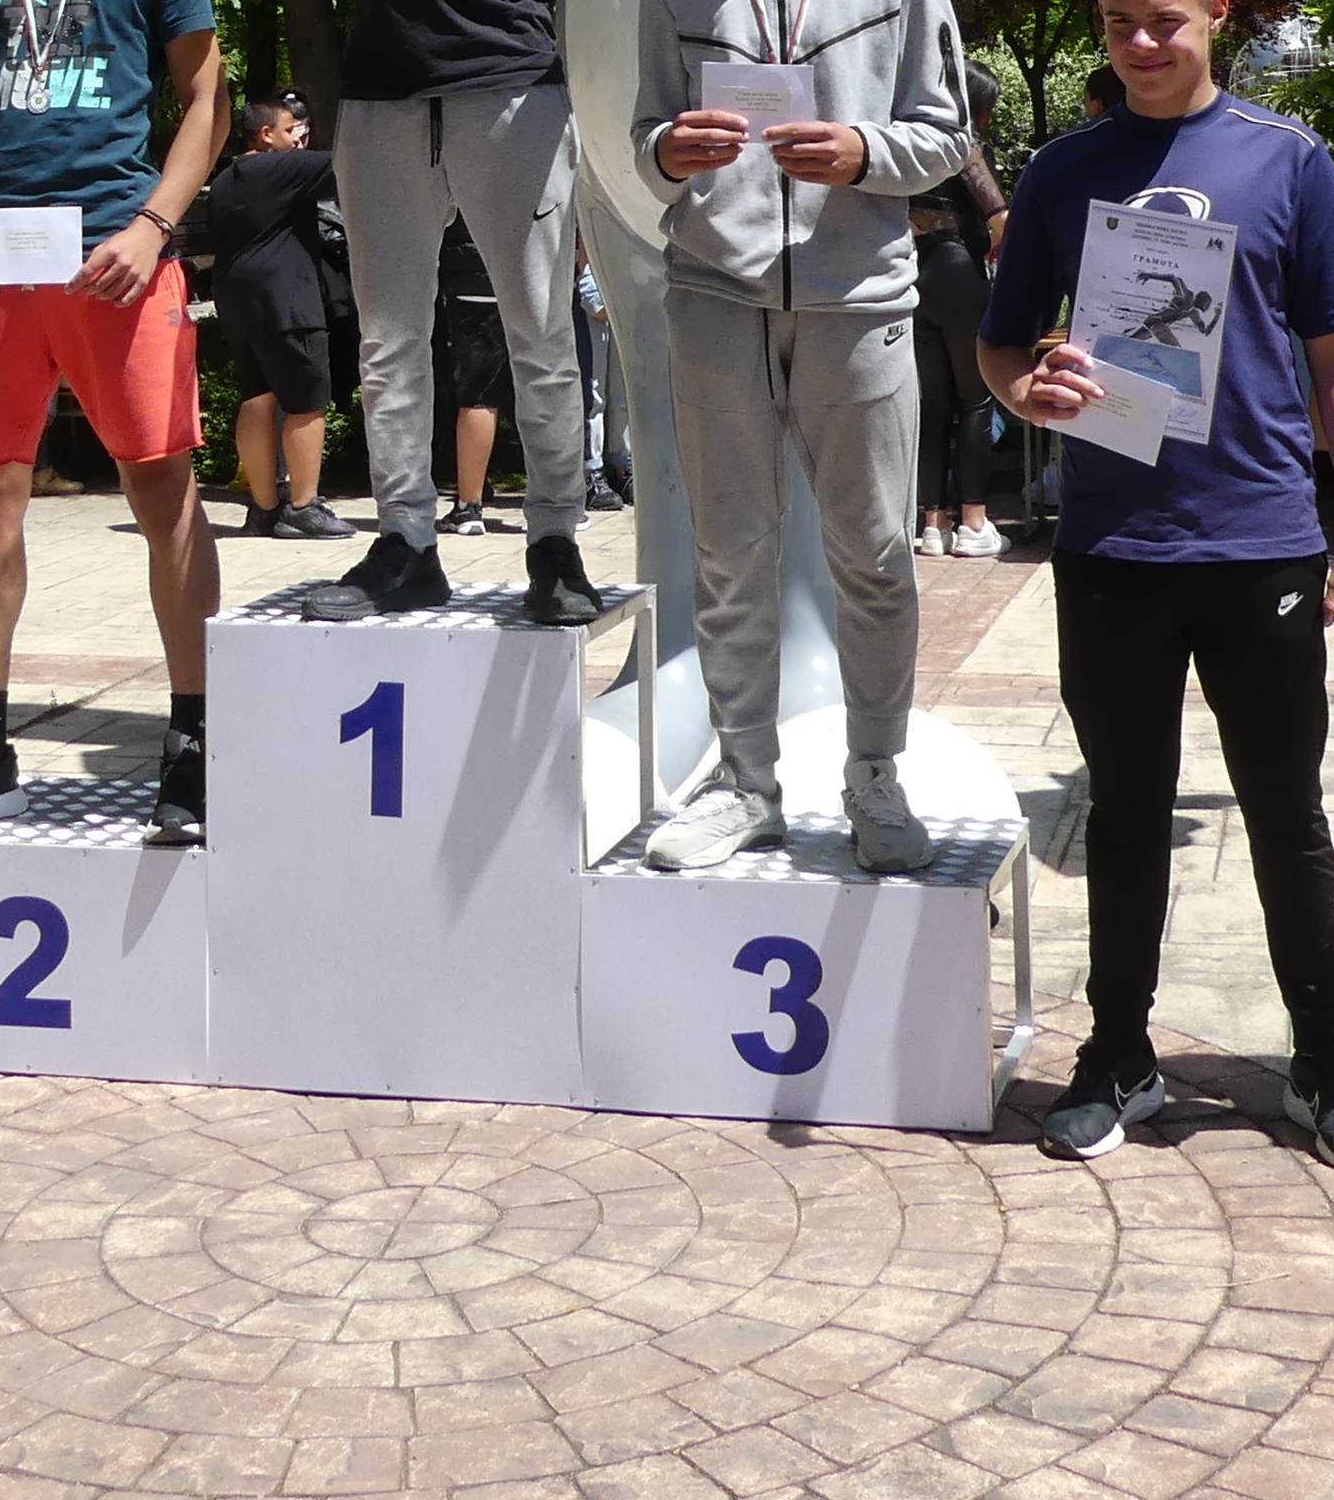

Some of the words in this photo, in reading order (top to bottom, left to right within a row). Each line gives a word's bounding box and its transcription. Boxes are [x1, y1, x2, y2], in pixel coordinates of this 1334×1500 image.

[1132, 254, 1180, 269] ГРАМОТА
[887, 323, 905, 337] NIKE
[339, 682, 404, 817] 1
[731, 935, 830, 1075] 3
